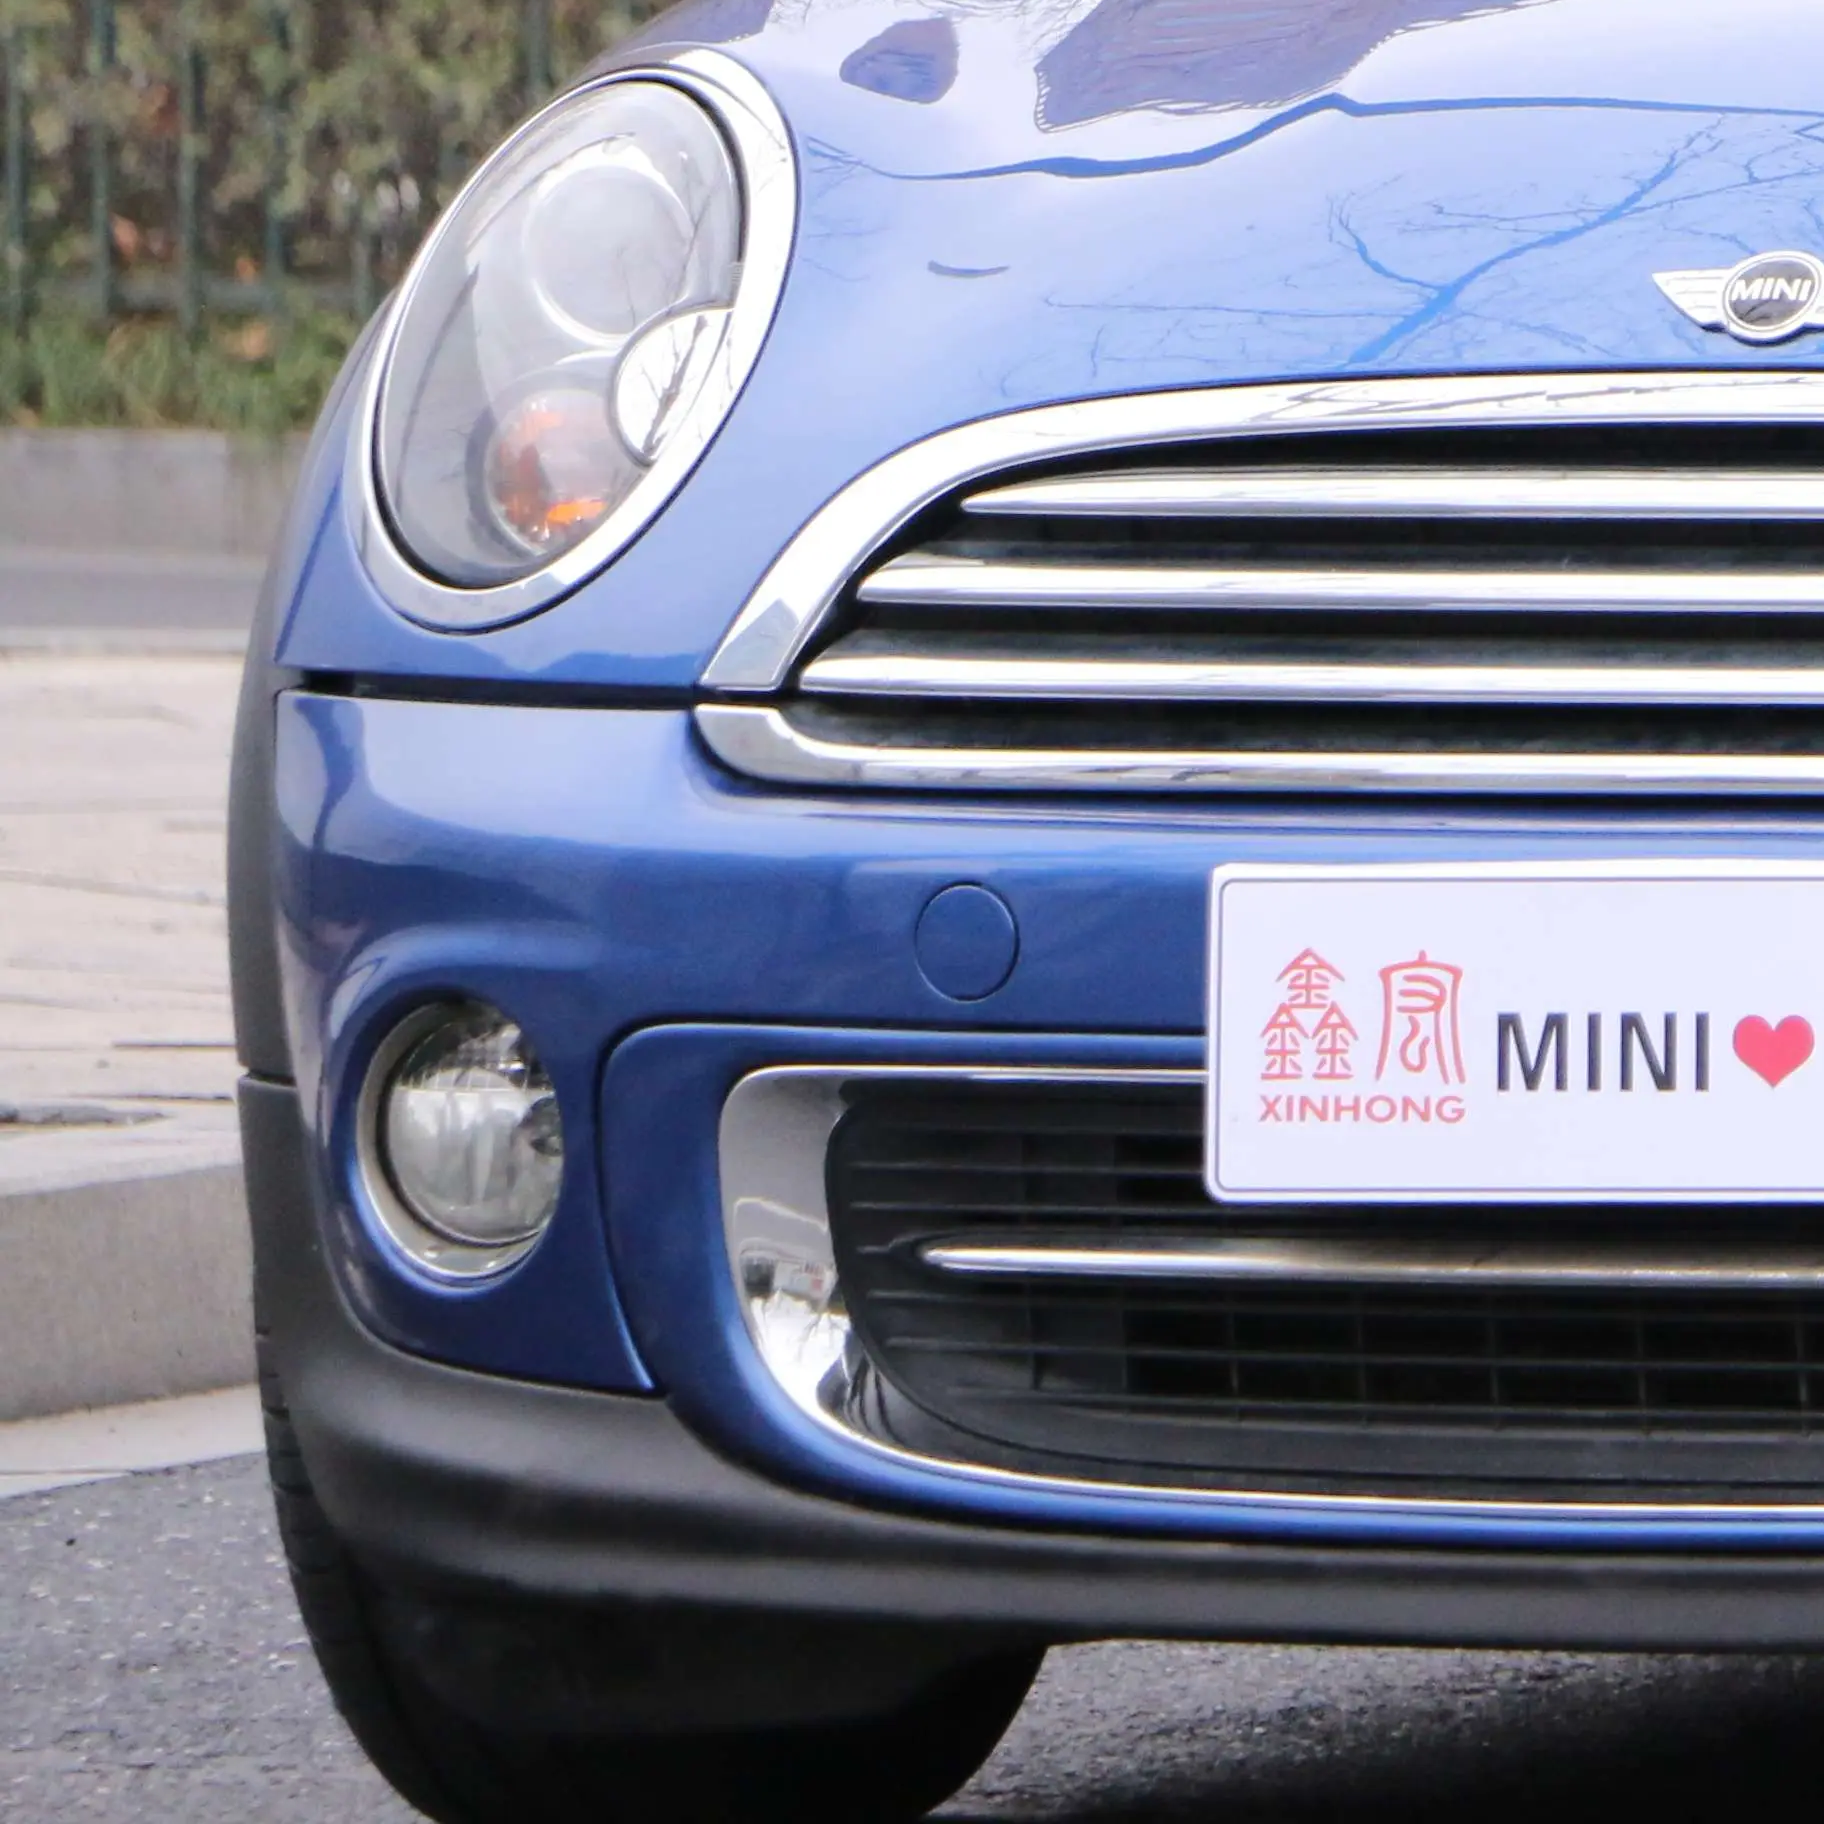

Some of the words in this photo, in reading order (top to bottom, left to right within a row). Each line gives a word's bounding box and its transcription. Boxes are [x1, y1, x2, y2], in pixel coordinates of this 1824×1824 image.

[1731, 277, 1812, 301] MINI
[1496, 1011, 1710, 1092] MINI
[1260, 1095, 1466, 1123] XINHONG
